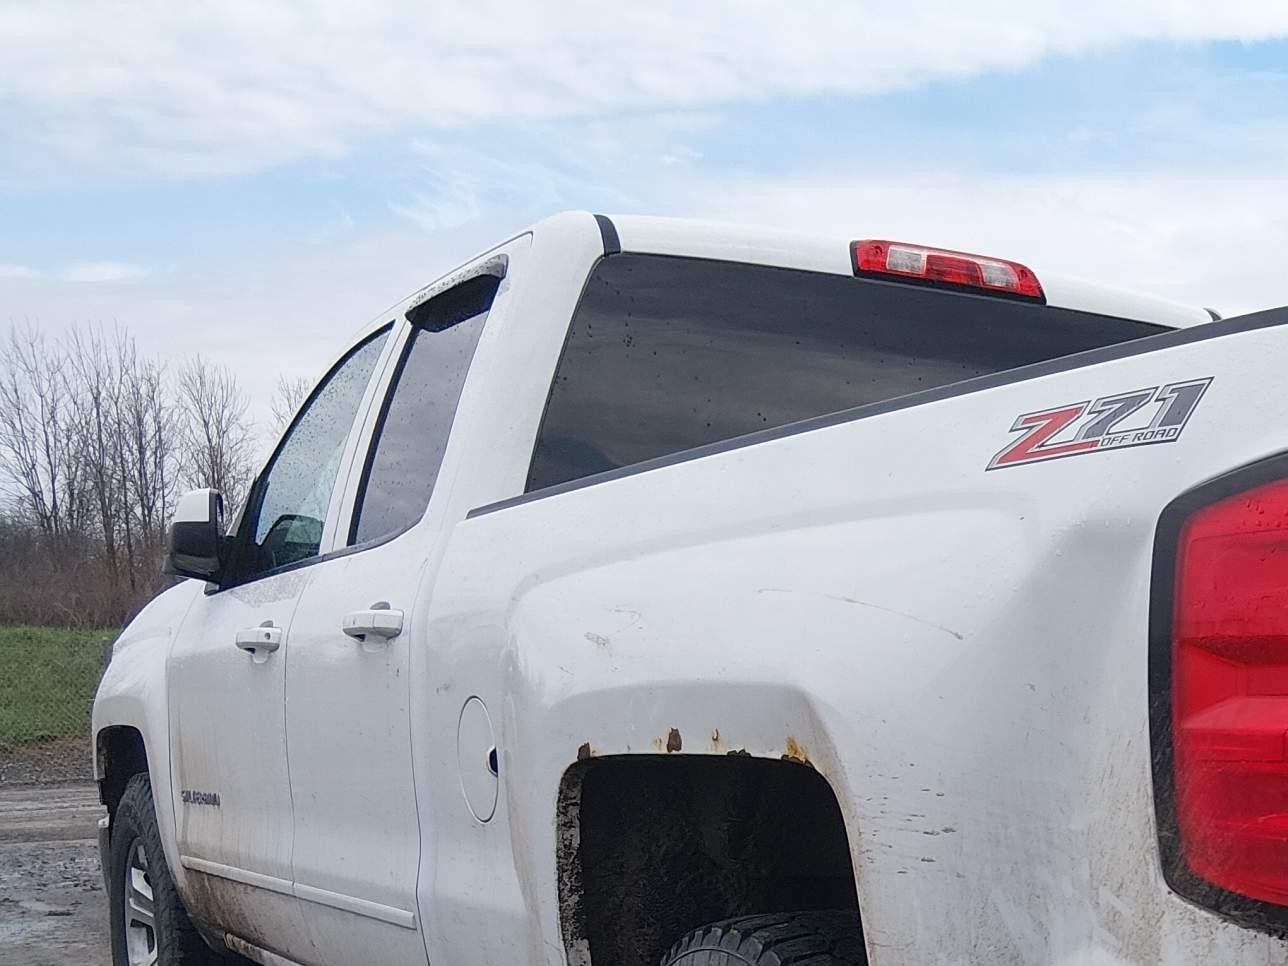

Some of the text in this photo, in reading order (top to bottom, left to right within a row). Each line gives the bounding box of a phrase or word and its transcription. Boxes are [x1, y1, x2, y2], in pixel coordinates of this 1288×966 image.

[985, 376, 1214, 471] Z71
[1100, 427, 1179, 447] OFF ROAD
